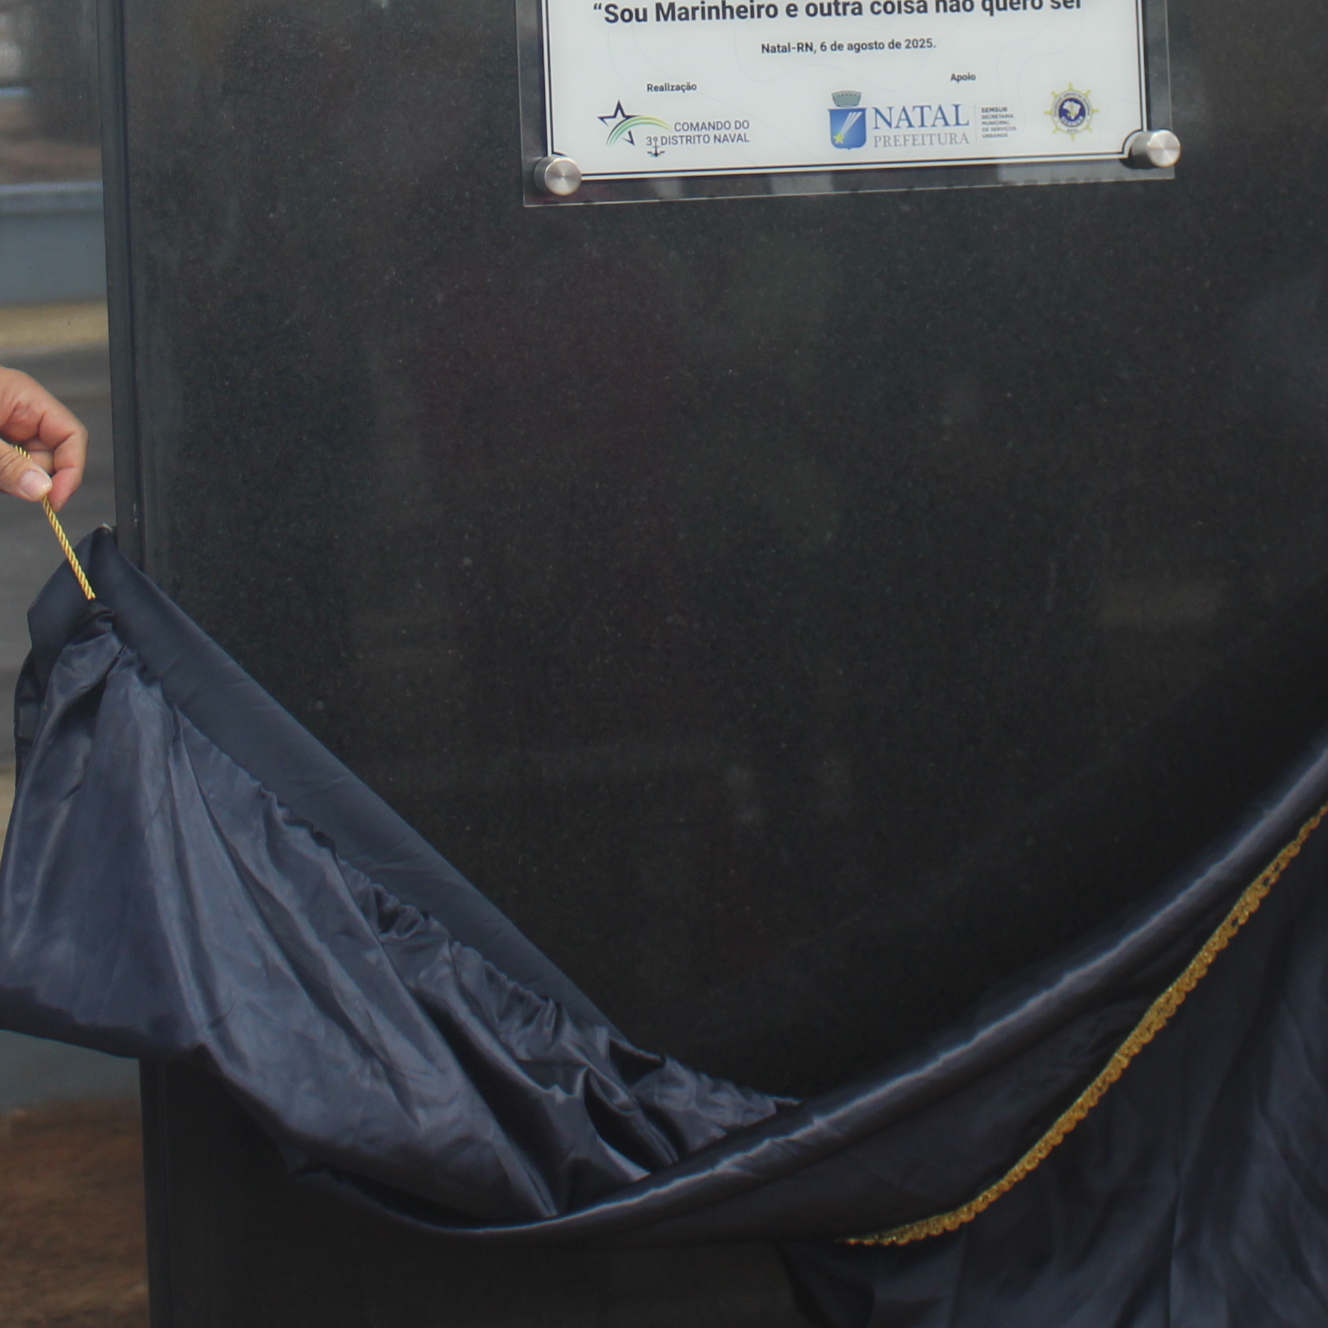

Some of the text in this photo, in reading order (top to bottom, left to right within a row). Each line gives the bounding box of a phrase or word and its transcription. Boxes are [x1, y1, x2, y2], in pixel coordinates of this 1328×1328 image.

[784, 3, 799, 19] e
[760, 38, 937, 55] Natal-RN, 6 de agosto de 2025.
[950, 72, 977, 84] Apoio
[646, 82, 698, 94] Realização
[872, 103, 970, 130] NATAL
[673, 119, 750, 133] COMANDO DO
[660, 134, 711, 146] DISTRITO
[713, 132, 751, 144] NAVAL
[872, 132, 970, 149] PREFEITURA
